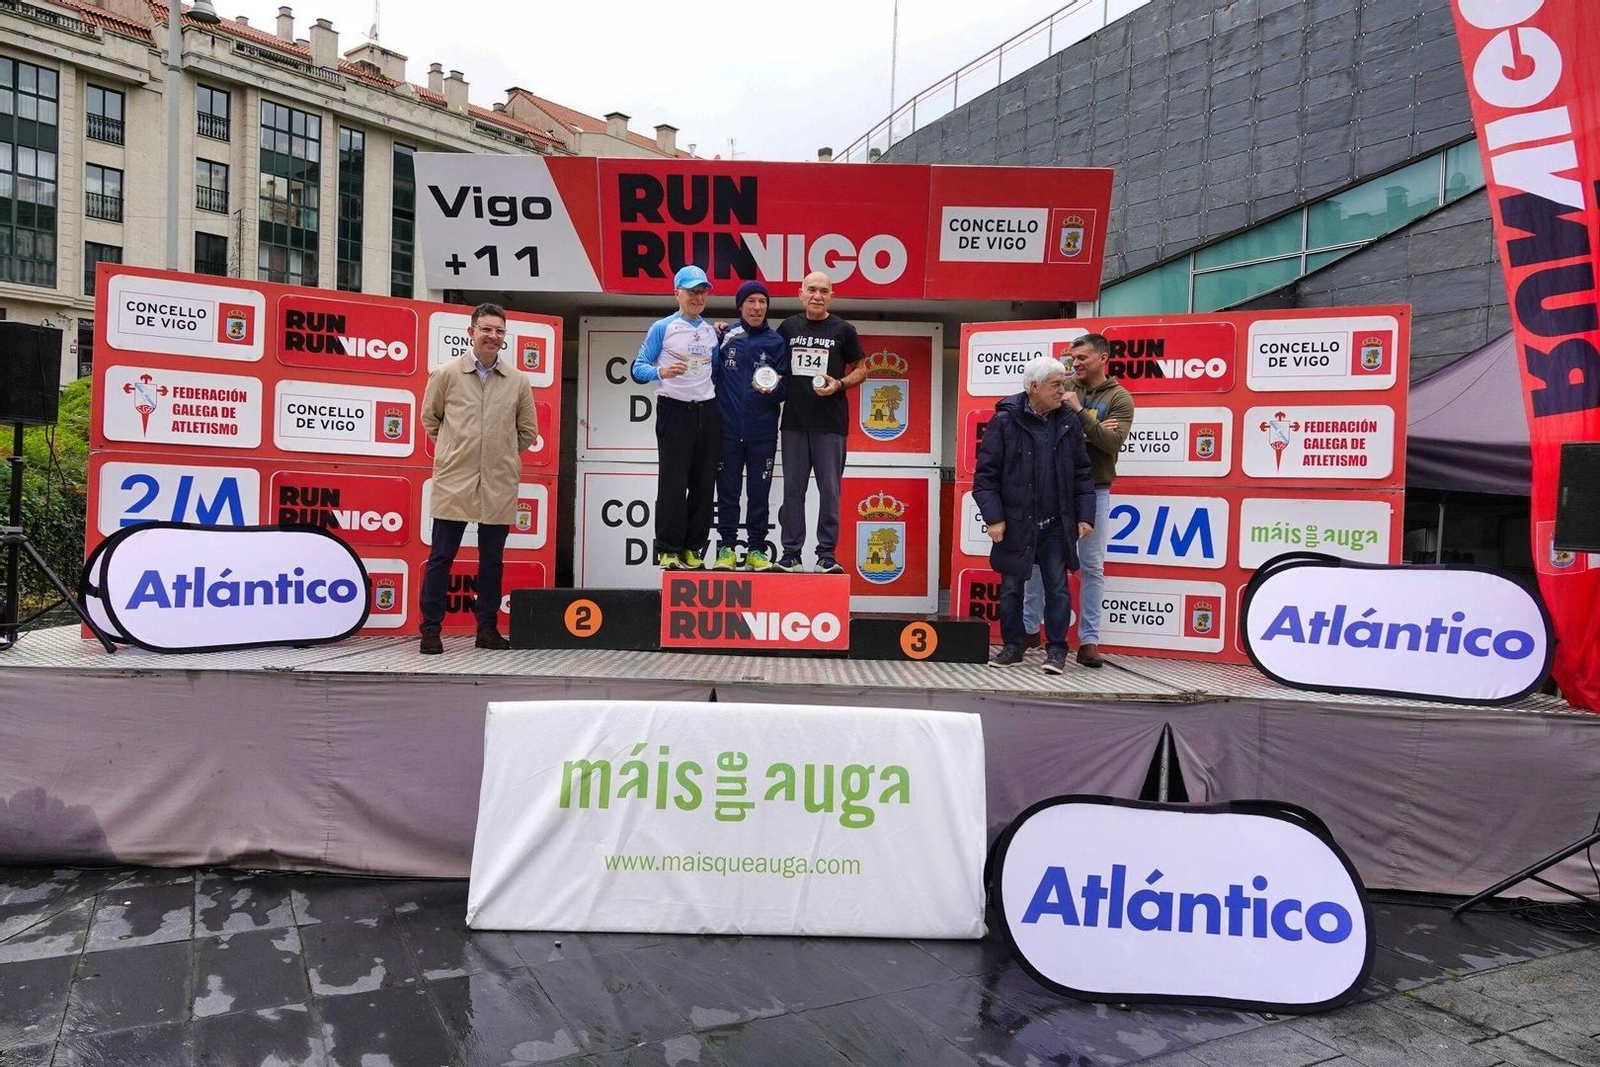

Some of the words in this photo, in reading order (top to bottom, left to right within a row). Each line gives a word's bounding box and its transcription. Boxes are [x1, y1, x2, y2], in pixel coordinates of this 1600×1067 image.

[428, 185, 552, 227] Vigo
[618, 173, 758, 226] RUN
[949, 218, 1039, 233] CONCELLO
[958, 236, 980, 250] DE
[987, 236, 1027, 250] VIGO
[126, 301, 207, 319] CONCELLO
[135, 315, 155, 327] DE
[161, 317, 197, 331] VIGO
[286, 309, 346, 334] RUN
[1108, 338, 1166, 359] RUN
[1259, 341, 1340, 355] CONCELLO
[796, 354, 822, 368] 134
[1268, 357, 1287, 368] DE
[1293, 355, 1330, 367] VIGO
[984, 365, 1000, 375] DE
[1004, 364, 1025, 375] VIG
[172, 386, 247, 403] FEDERACIÓN
[172, 404, 219, 418] GALEGA
[221, 406, 236, 419] DE
[287, 403, 365, 419] CONCELLO
[171, 420, 238, 436] ATLETISMO
[296, 418, 315, 429] DE
[320, 419, 355, 432] VIGO
[1304, 418, 1377, 433] FEDERACIÓN
[1127, 431, 1179, 441] NCELLO
[1303, 438, 1348, 450] GALEGA
[1351, 438, 1366, 450] DE
[1140, 443, 1171, 453] VIGO
[1302, 454, 1368, 467] ATLETISMO
[279, 486, 341, 508] RUN
[1250, 521, 1302, 544] máis
[1305, 524, 1320, 548] que
[1323, 528, 1378, 551] auga
[125, 566, 358, 610] Atlántico
[670, 579, 752, 609] RUN
[1101, 599, 1174, 613] CONCELLO
[575, 605, 591, 630] 2
[1109, 613, 1127, 624] DE
[1132, 614, 1165, 626] VIGO
[1260, 604, 1535, 660] Atlántico
[911, 629, 927, 653] 3
[559, 742, 704, 811] máis
[714, 750, 755, 823] que
[764, 762, 911, 829] auga
[604, 852, 861, 878] www.maisqueauga.com
[1020, 864, 1353, 944] Atlántico
